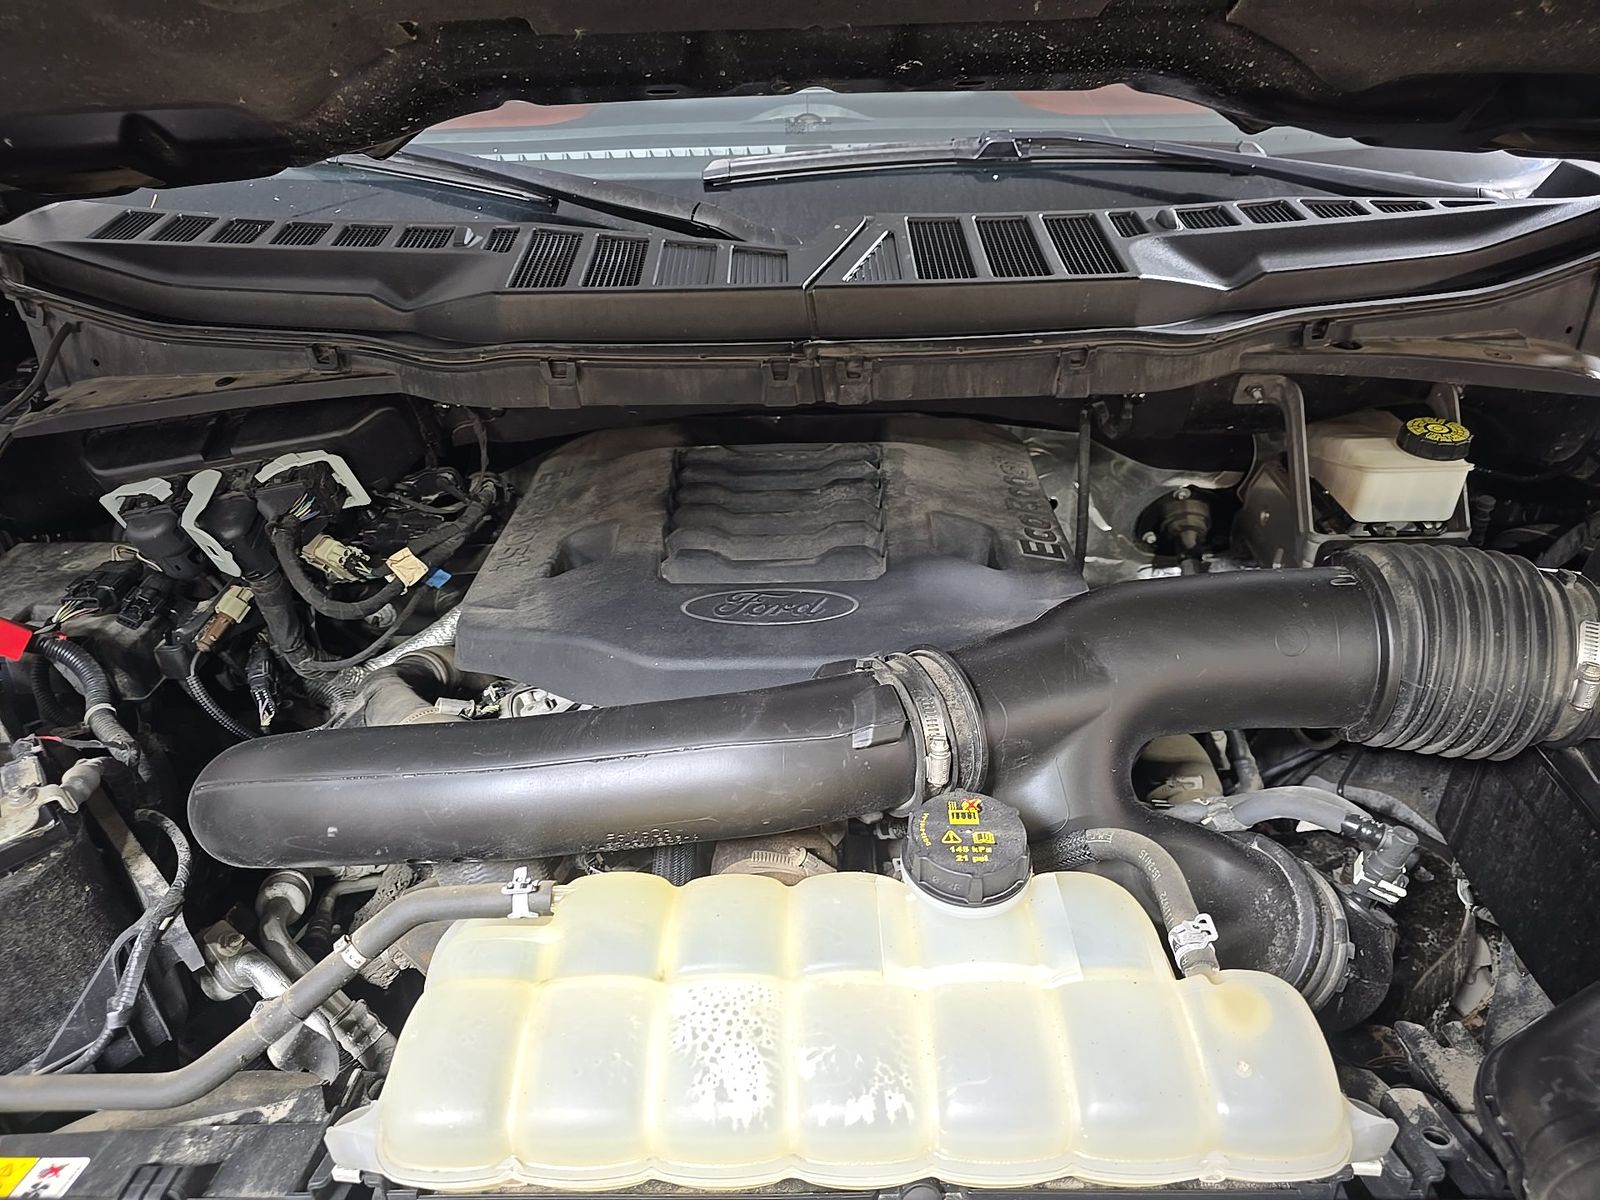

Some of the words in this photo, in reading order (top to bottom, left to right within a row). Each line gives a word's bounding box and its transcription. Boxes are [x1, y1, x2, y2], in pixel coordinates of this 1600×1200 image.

[713, 591, 828, 618] Ford
[949, 845, 970, 854] 145
[955, 854, 969, 863] 21
